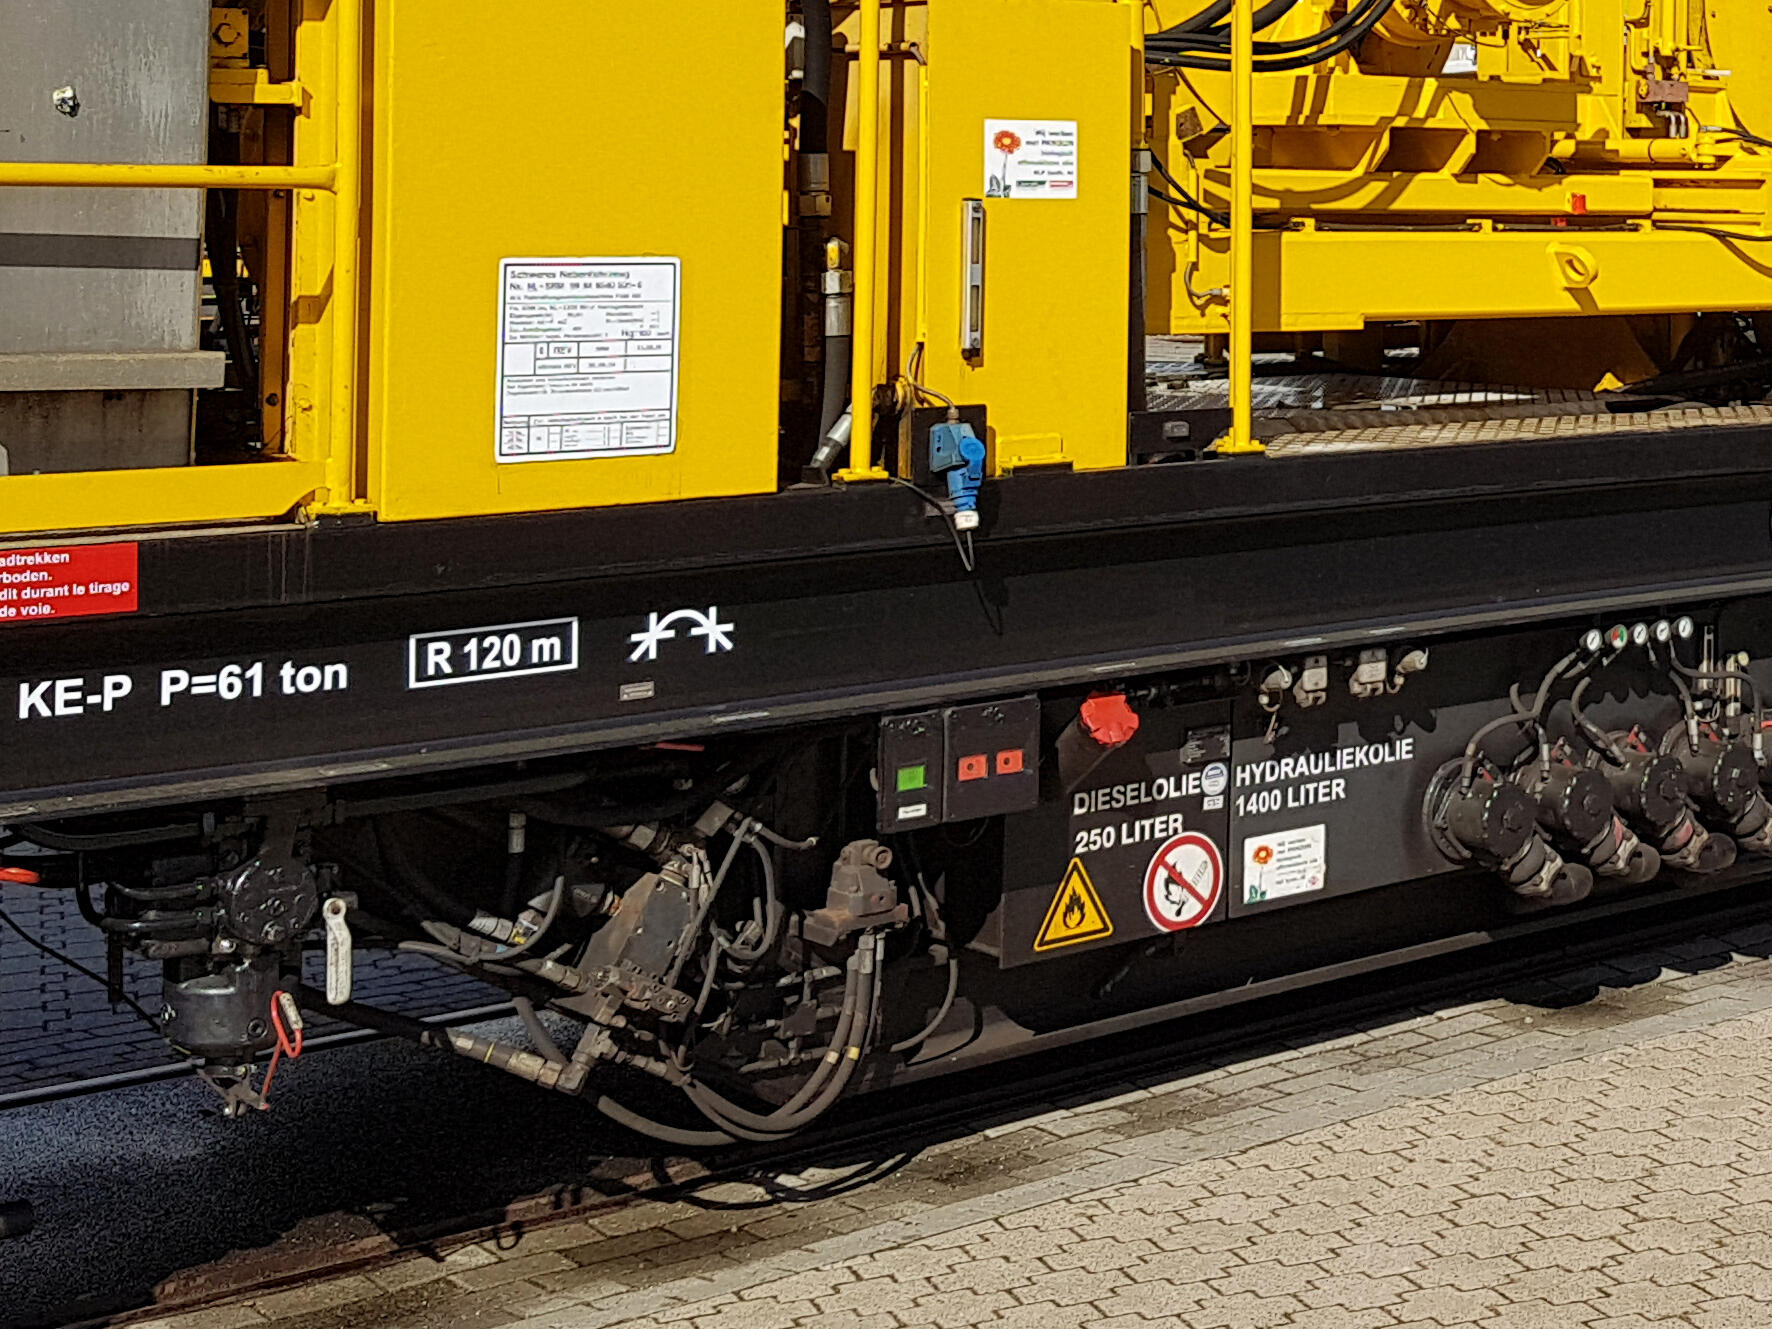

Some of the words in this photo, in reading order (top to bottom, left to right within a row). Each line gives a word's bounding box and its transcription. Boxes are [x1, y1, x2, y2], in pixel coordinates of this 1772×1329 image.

[20, 602, 56, 616] voie.
[21, 584, 70, 599] durant
[73, 583, 86, 595] le
[89, 581, 130, 596] tirage
[426, 641, 452, 676] R
[464, 633, 521, 671] 120
[530, 635, 562, 664] m
[18, 674, 133, 719] KE-P
[160, 661, 265, 706] P=61
[279, 660, 347, 694] ton
[1235, 738, 1415, 788] HYDRAULIEKOLIE
[1073, 771, 1201, 816] DIESELOLIE
[1235, 789, 1282, 817] 1400
[1287, 778, 1347, 808] LITER
[1074, 827, 1116, 855] 250
[1121, 813, 1184, 846] LITER
